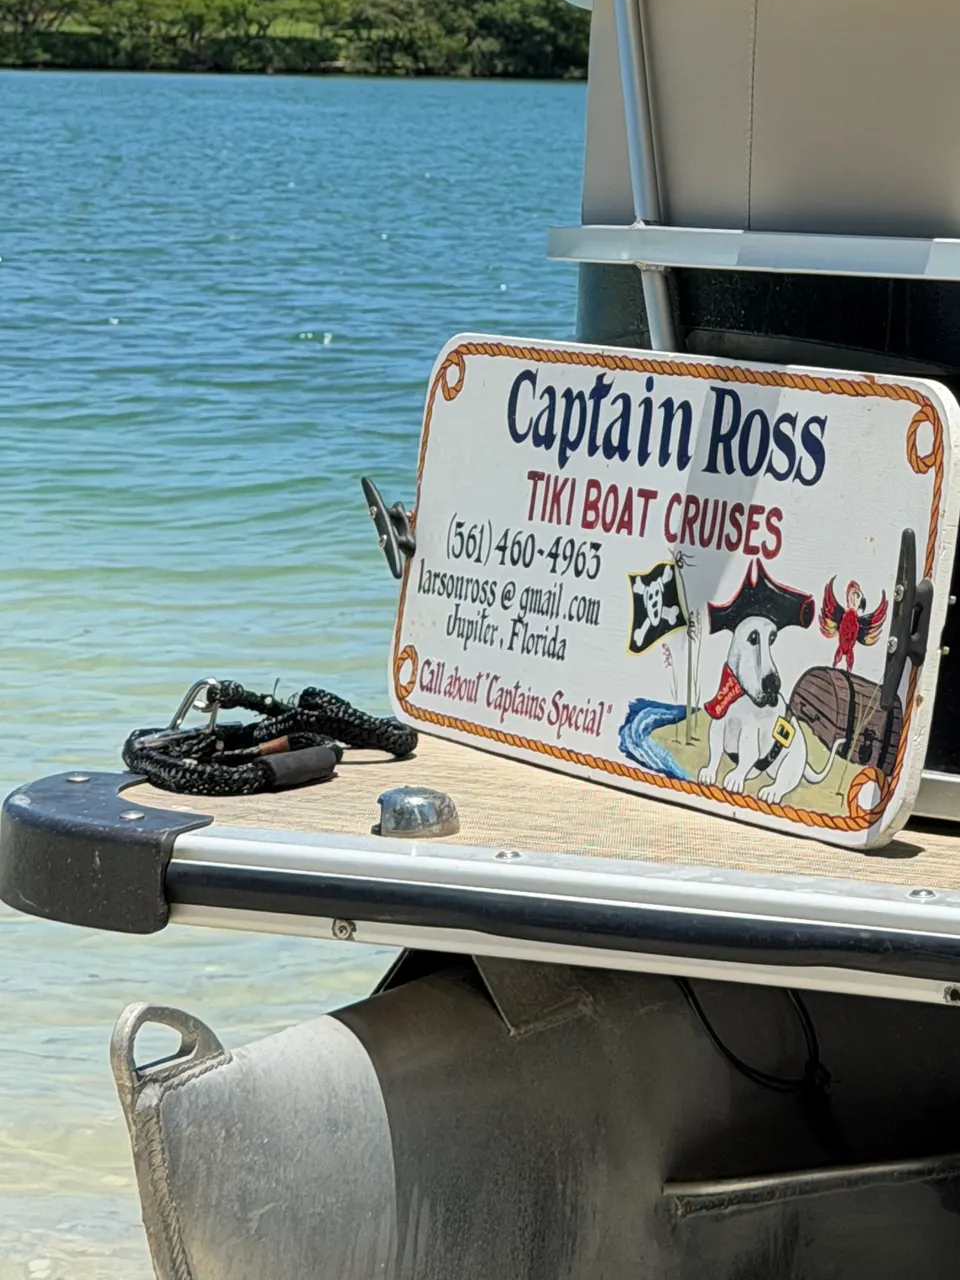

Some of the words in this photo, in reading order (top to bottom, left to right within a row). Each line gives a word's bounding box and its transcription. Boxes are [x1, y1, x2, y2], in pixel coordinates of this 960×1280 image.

[507, 368, 693, 471] Captain
[701, 386, 828, 486] Ross
[446, 512, 493, 566] (561)
[494, 528, 602, 580] 460-4963
[527, 470, 577, 526] TIKI
[581, 478, 658, 538] BOAT
[664, 492, 783, 560] CRUISES
[507, 617, 567, 661] Florida
[419, 658, 446, 696] Call
[443, 666, 483, 704] about
